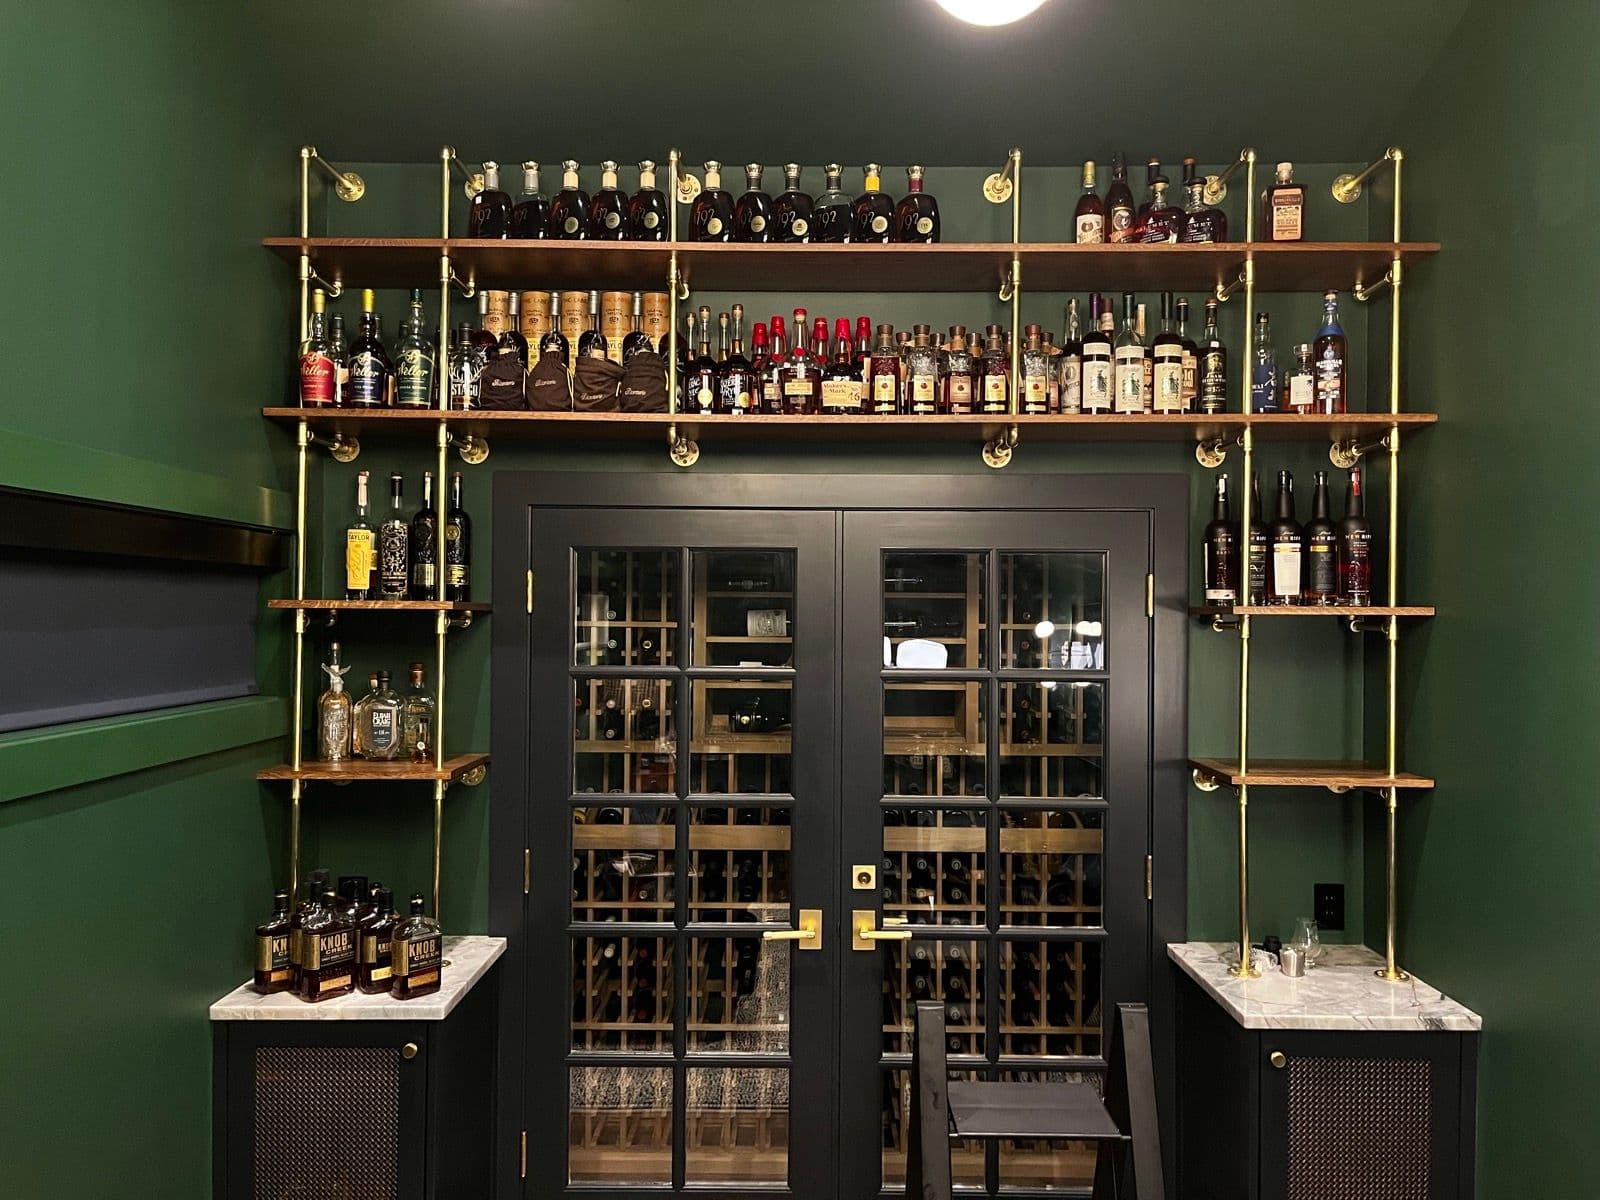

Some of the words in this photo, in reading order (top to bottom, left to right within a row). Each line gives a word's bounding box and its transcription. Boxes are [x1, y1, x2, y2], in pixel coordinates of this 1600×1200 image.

[272, 938, 288, 953] KN
[320, 932, 348, 953] KNOB
[326, 944, 353, 955] CREEK
[409, 939, 436, 958] KNOB
